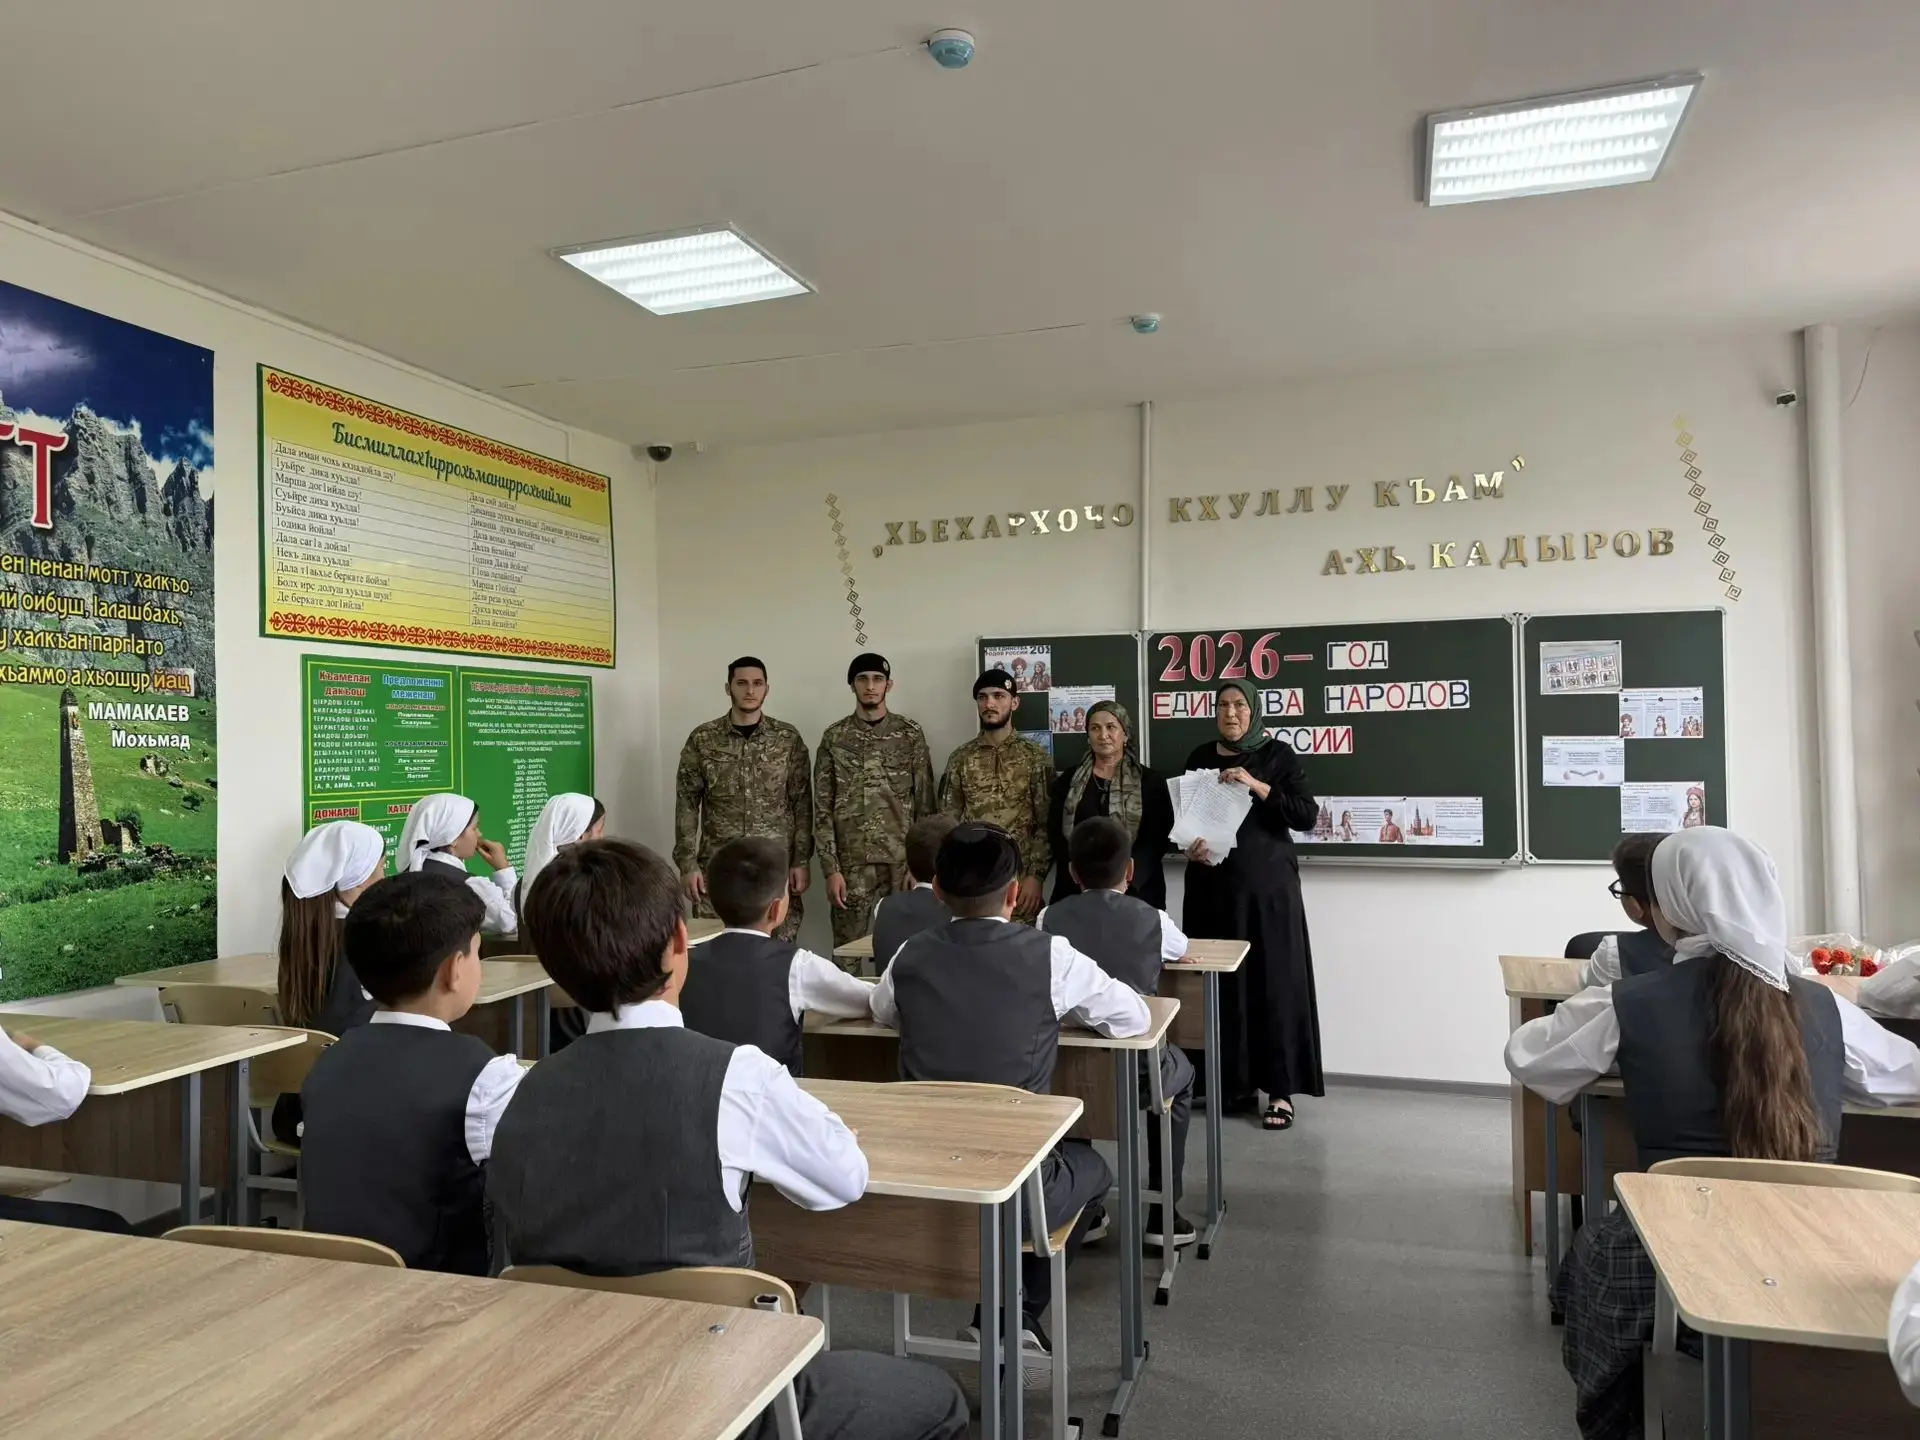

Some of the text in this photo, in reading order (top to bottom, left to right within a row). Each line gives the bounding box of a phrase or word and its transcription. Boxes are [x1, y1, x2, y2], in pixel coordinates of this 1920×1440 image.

[275, 442, 296, 457] Дала
[0, 423, 70, 529] Т
[275, 472, 306, 488] Марша
[275, 487, 307, 503] Суьйре
[1168, 485, 1350, 523] КХУЛЛУ
[276, 502, 306, 517] Буьйса
[276, 532, 298, 546] Дала
[1429, 527, 1675, 570] КАДЫРОВ
[30, 559, 84, 580] ненан
[88, 567, 130, 583] мотт
[134, 572, 194, 596] халкъо,
[276, 562, 298, 574] Дала
[277, 576, 298, 589] Болх
[22, 588, 90, 619] ойбуш,
[277, 592, 289, 602] Де
[12, 629, 88, 650] халкъан
[1328, 642, 1388, 669] ГОД
[71, 670, 82, 686] а
[85, 669, 149, 693] хьошур
[153, 670, 192, 693] йац
[1325, 682, 1469, 711] НАРОДОВ
[88, 702, 190, 721] МАМАКАЕВ
[111, 731, 191, 750] Мохьмад
[313, 807, 360, 820] ДОЖАРШ
